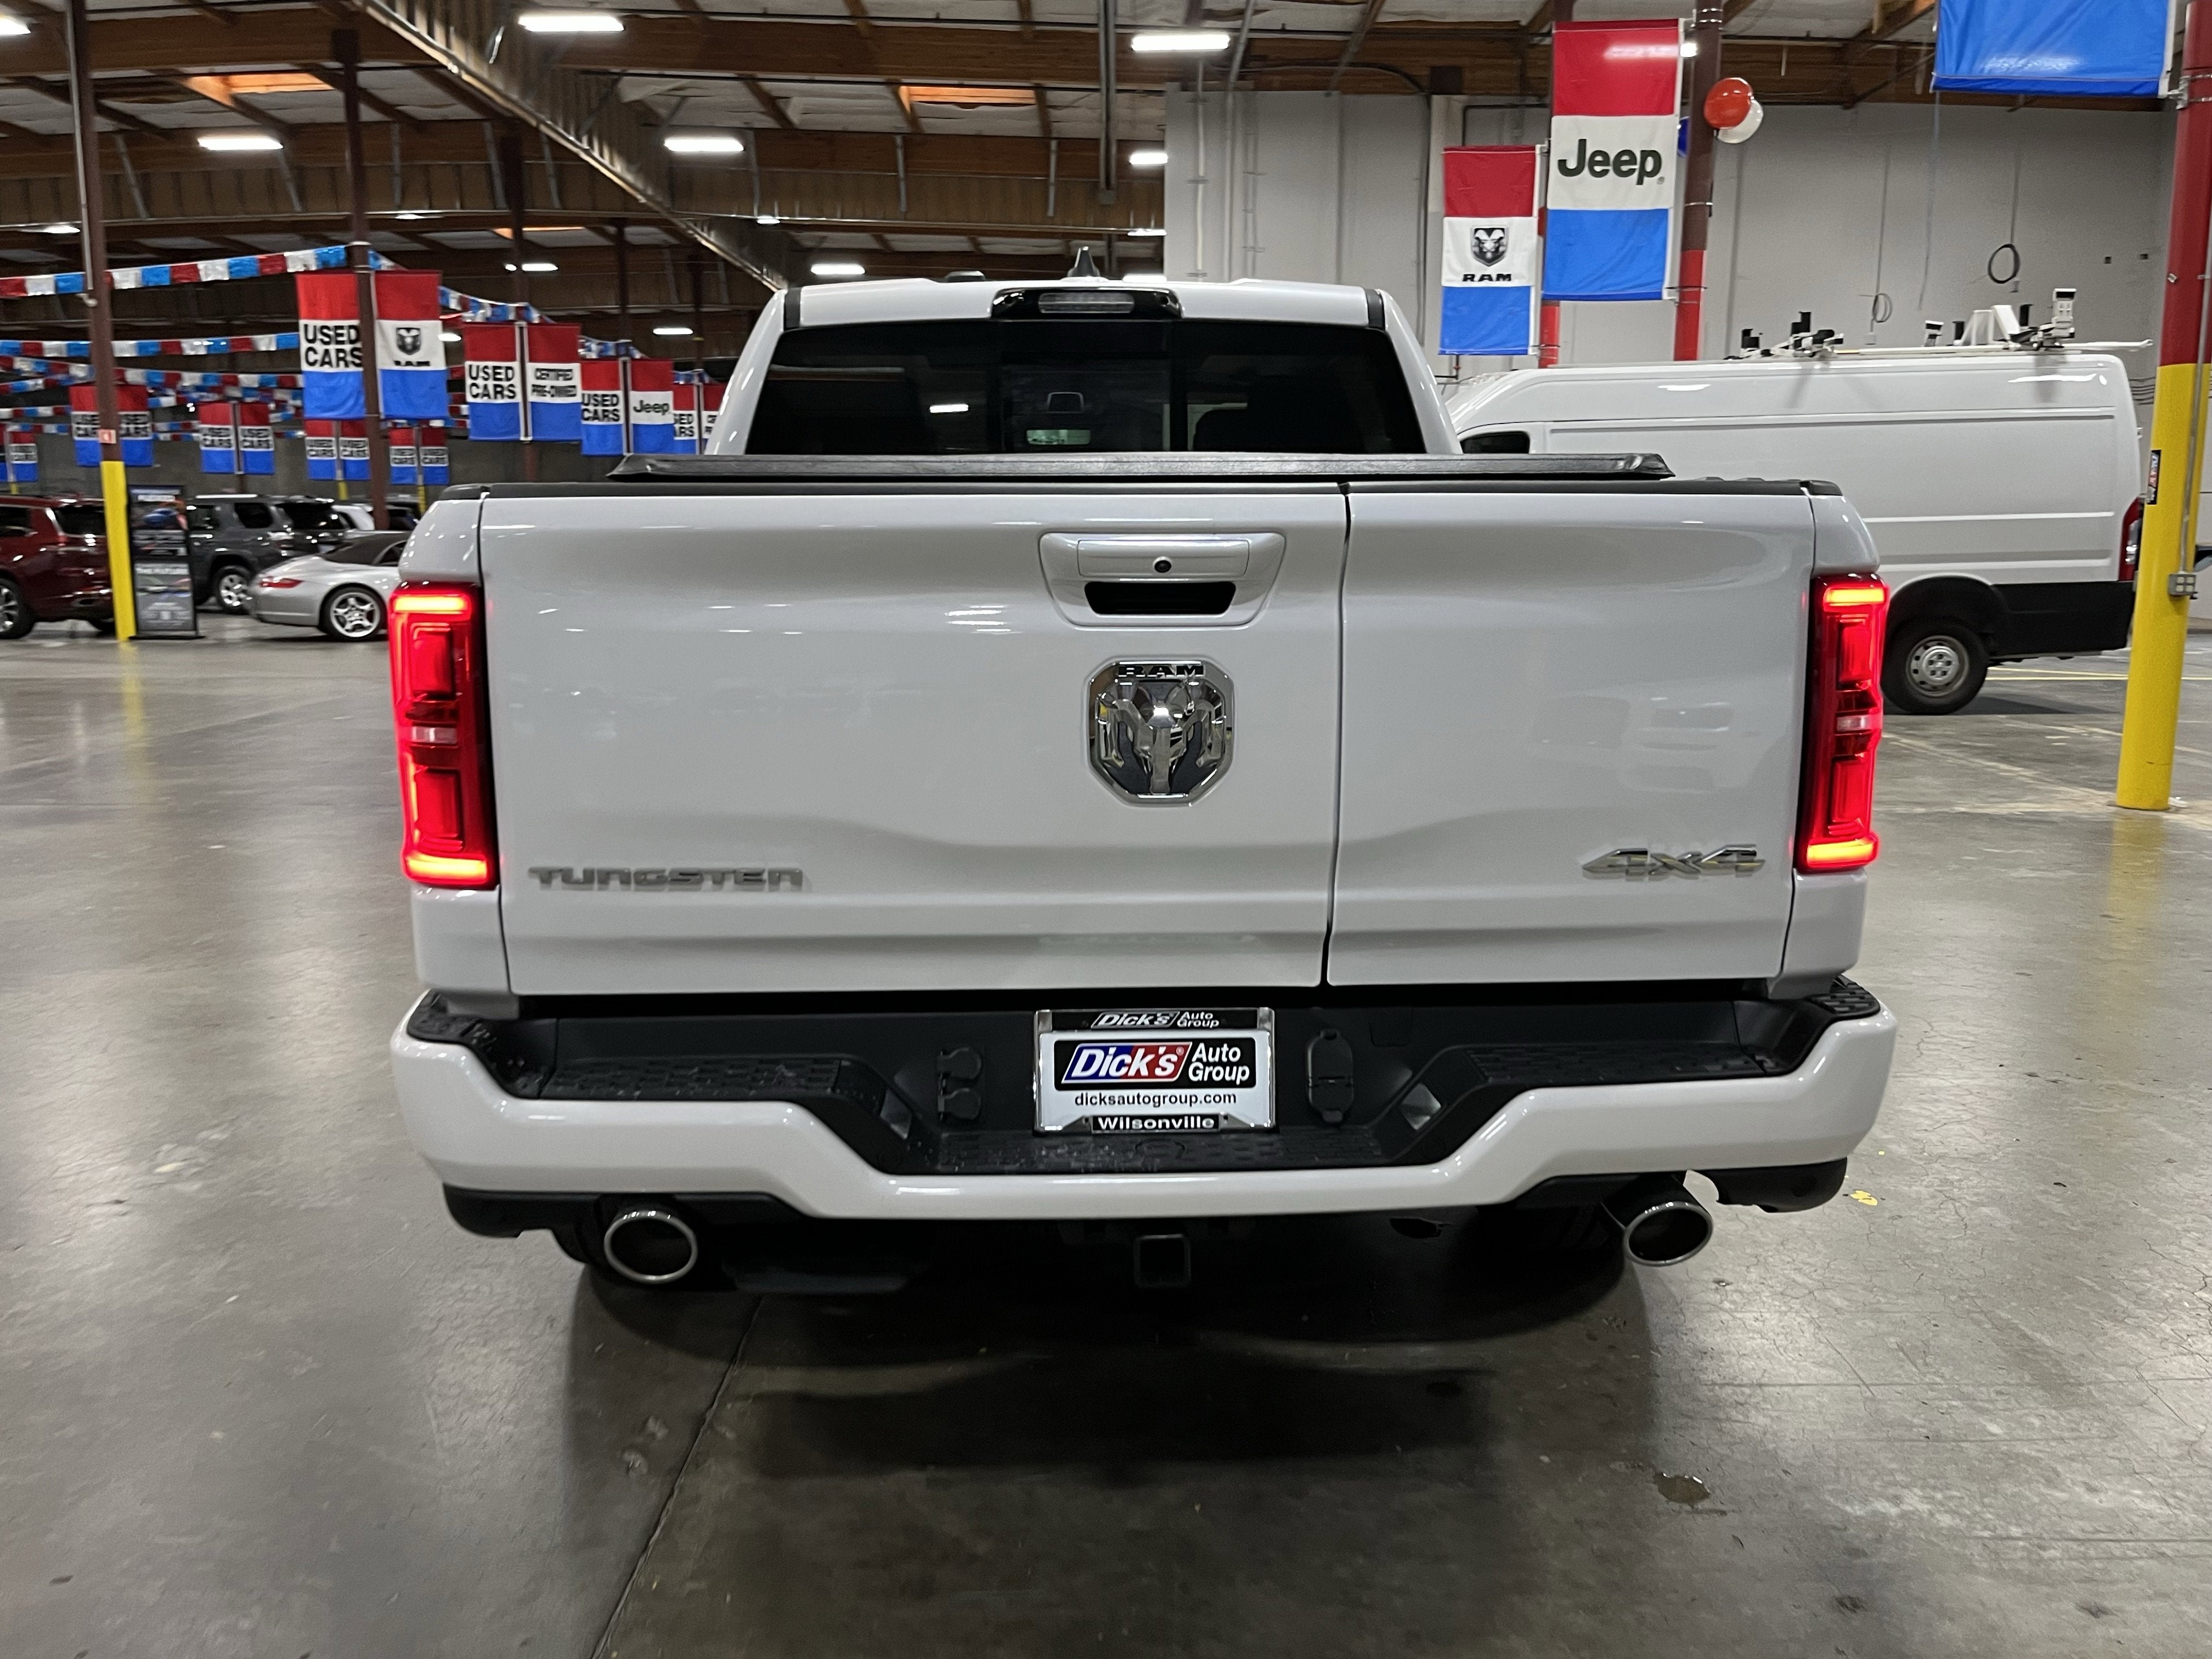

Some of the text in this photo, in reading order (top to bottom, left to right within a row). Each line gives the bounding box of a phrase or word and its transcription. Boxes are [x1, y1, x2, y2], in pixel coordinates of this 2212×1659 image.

[1558, 139, 1662, 185] Jeep
[1462, 274, 1512, 282] RAM
[304, 324, 360, 345] USED
[305, 347, 362, 368] CARS
[469, 364, 515, 382] USED
[469, 382, 516, 399] CARS
[582, 393, 619, 407] USED
[633, 400, 670, 415] Jeep
[582, 408, 620, 422] CARS
[1117, 664, 1205, 679] RAM
[528, 866, 803, 891] TUNGSTEN
[1177, 1019, 1220, 1029] Group
[1192, 1043, 1242, 1063] Auto
[1188, 1062, 1250, 1085] Group
[1074, 1092, 1237, 1108] dicksautogroup.com
[1098, 1115, 1215, 1131] Wilsonville
